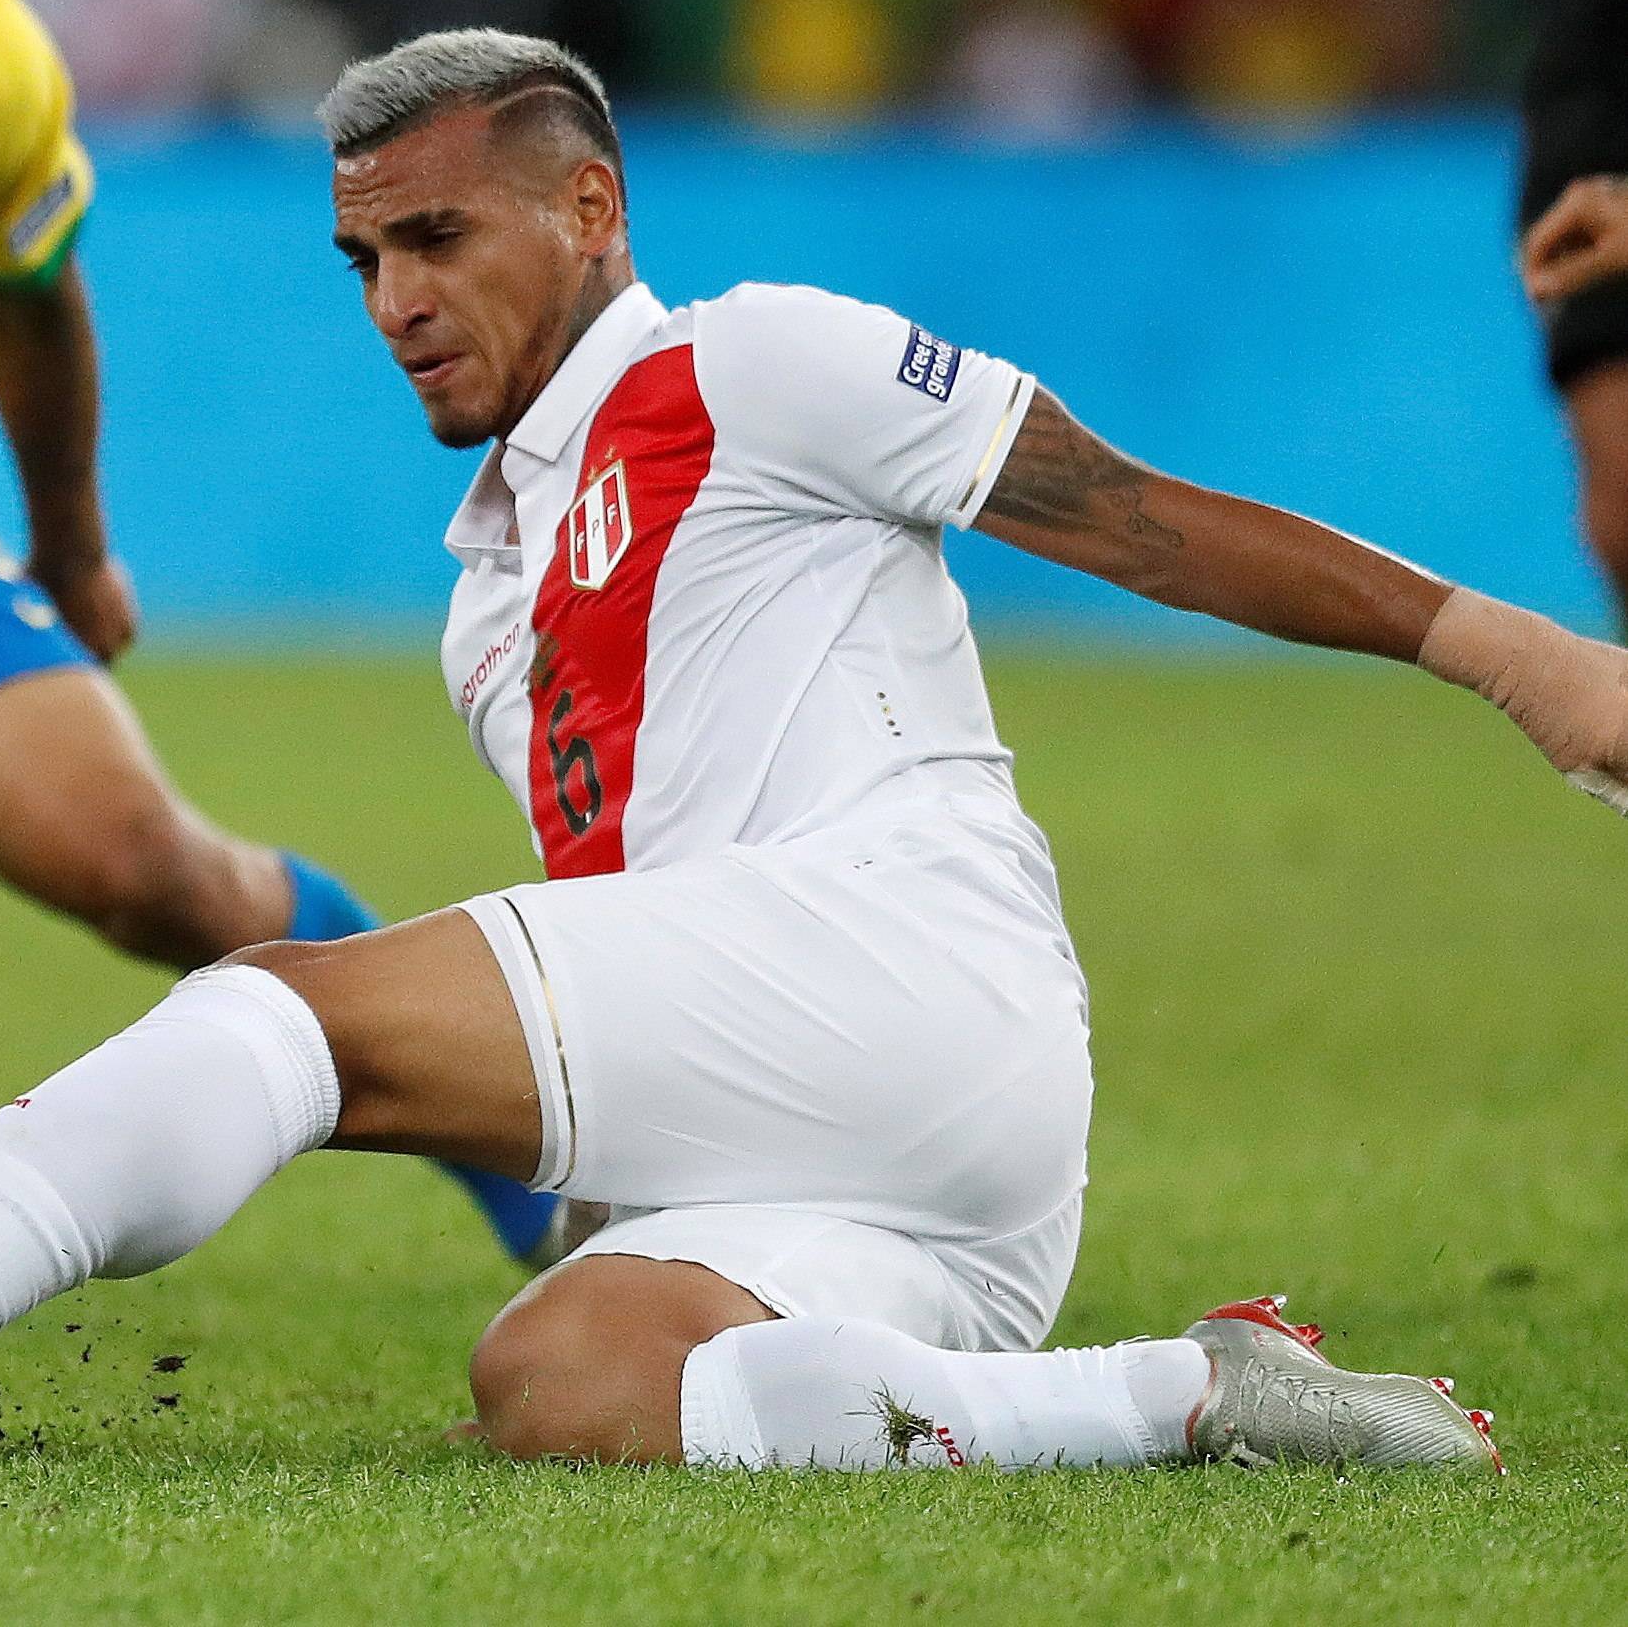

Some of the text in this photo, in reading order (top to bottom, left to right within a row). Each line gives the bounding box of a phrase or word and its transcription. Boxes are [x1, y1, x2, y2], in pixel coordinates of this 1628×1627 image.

[902, 343, 932, 385] Cree
[576, 503, 618, 554] FPF
[461, 622, 521, 708] arathon
[548, 689, 602, 837] 6
